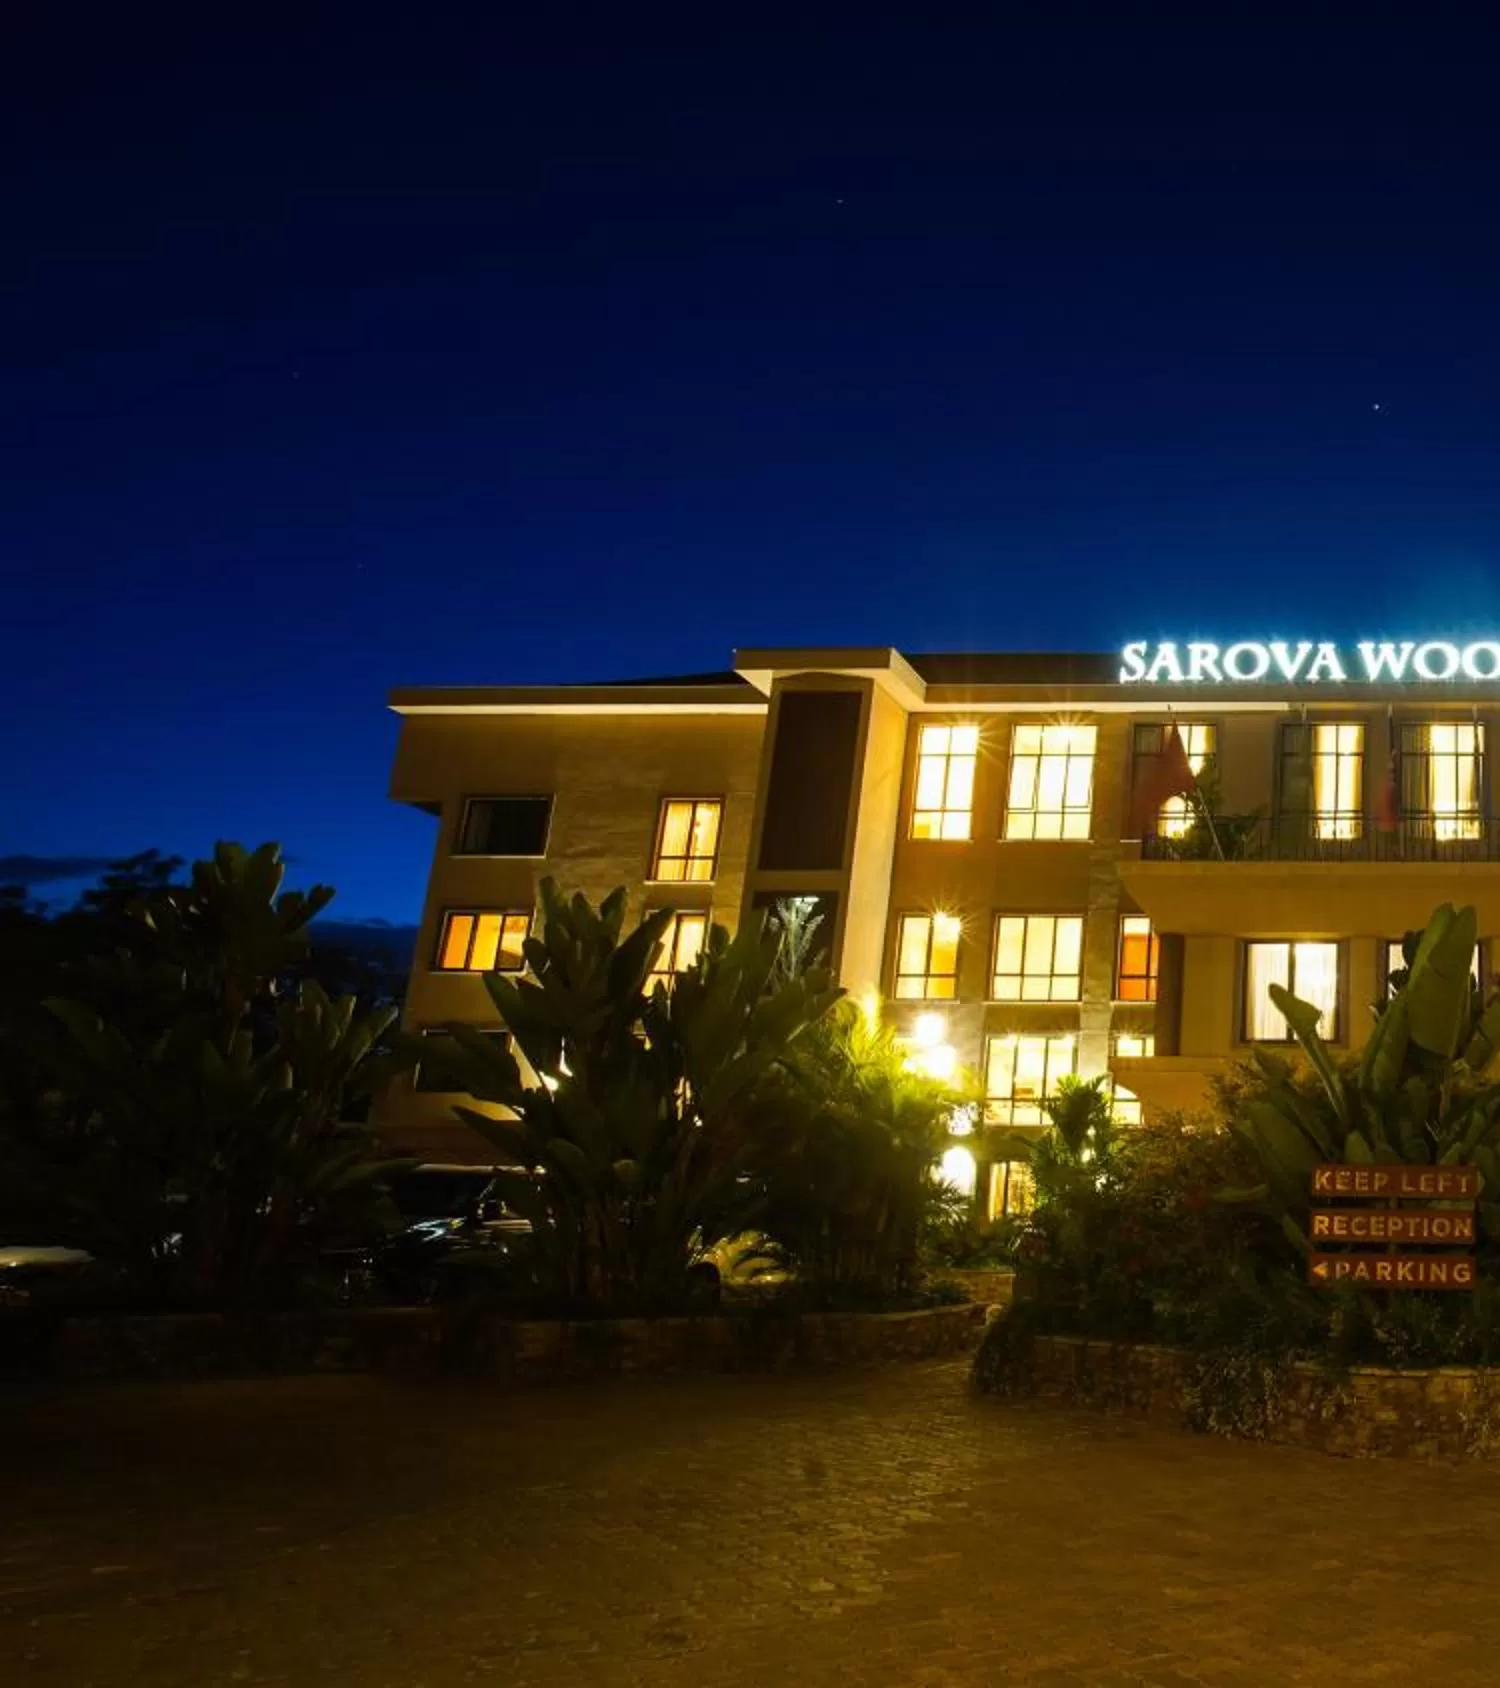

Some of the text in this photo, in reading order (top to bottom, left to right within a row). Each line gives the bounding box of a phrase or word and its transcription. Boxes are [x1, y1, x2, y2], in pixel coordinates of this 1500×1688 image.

[1118, 640, 1346, 682] SAROVA
[1314, 1170, 1472, 1193] KEEP LEFT
[1313, 1215, 1472, 1237] RECEPTION
[1335, 1261, 1472, 1282] PARKING
